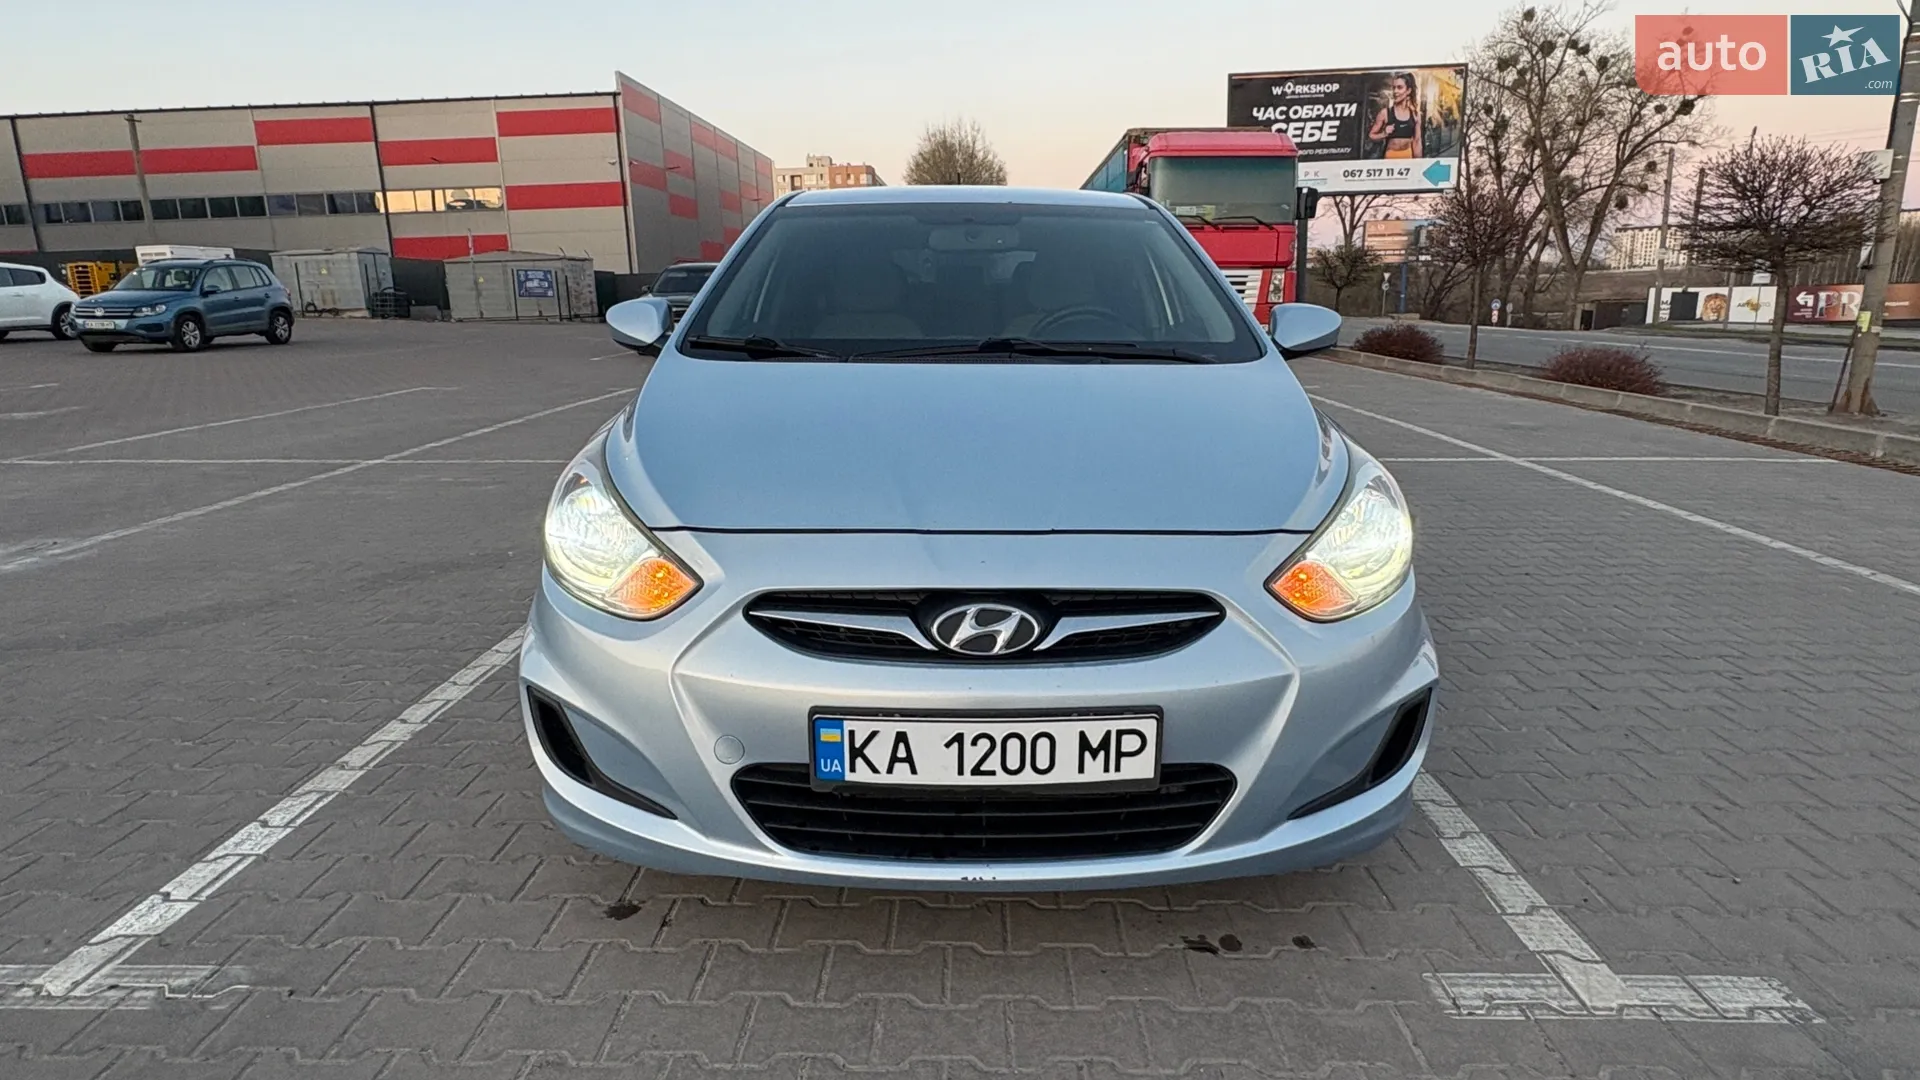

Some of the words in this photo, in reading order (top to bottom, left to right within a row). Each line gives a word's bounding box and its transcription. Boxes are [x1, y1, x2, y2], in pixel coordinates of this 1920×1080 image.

[1271, 82, 1340, 96] WORKSHOP
[1252, 106, 1288, 120] ЧАС
[1288, 103, 1358, 120] ОБРАТИ
[1342, 169, 1363, 179] 067
[1366, 168, 1383, 178] 517
[1386, 168, 1395, 177] 11
[1397, 167, 1411, 177] 47
[847, 729, 919, 776] KA
[943, 731, 1057, 777] 1200
[1077, 728, 1149, 775] MP
[820, 758, 843, 774] UA
